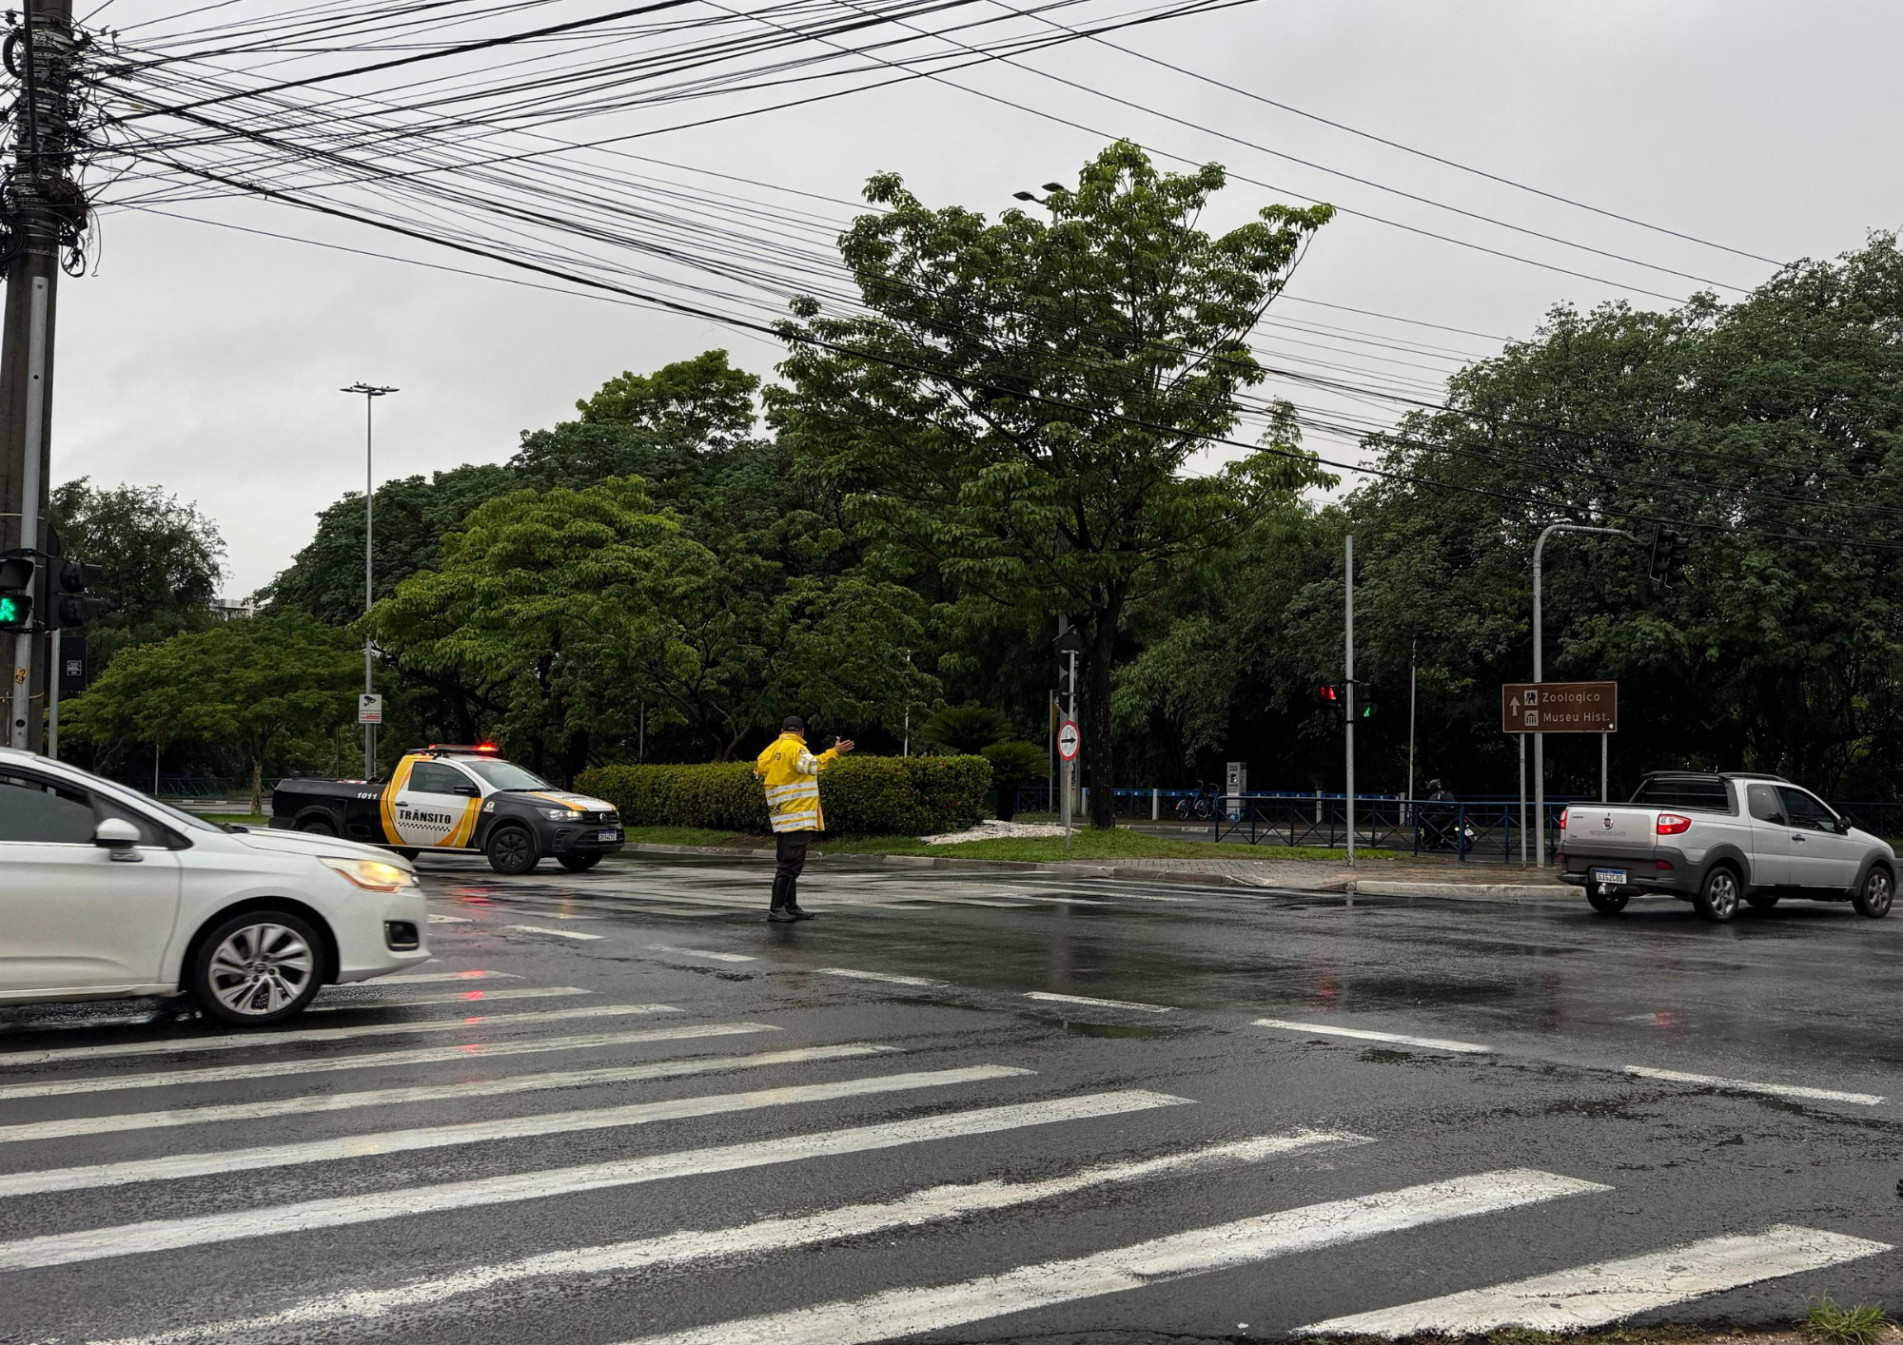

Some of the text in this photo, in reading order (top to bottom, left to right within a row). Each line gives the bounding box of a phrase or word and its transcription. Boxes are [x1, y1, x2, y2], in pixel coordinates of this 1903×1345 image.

[1542, 691, 1600, 704] Zoológico
[1543, 711, 1610, 722] Museu Hist.
[357, 792, 377, 800] 1011
[399, 809, 452, 825] TRÂNSITO
